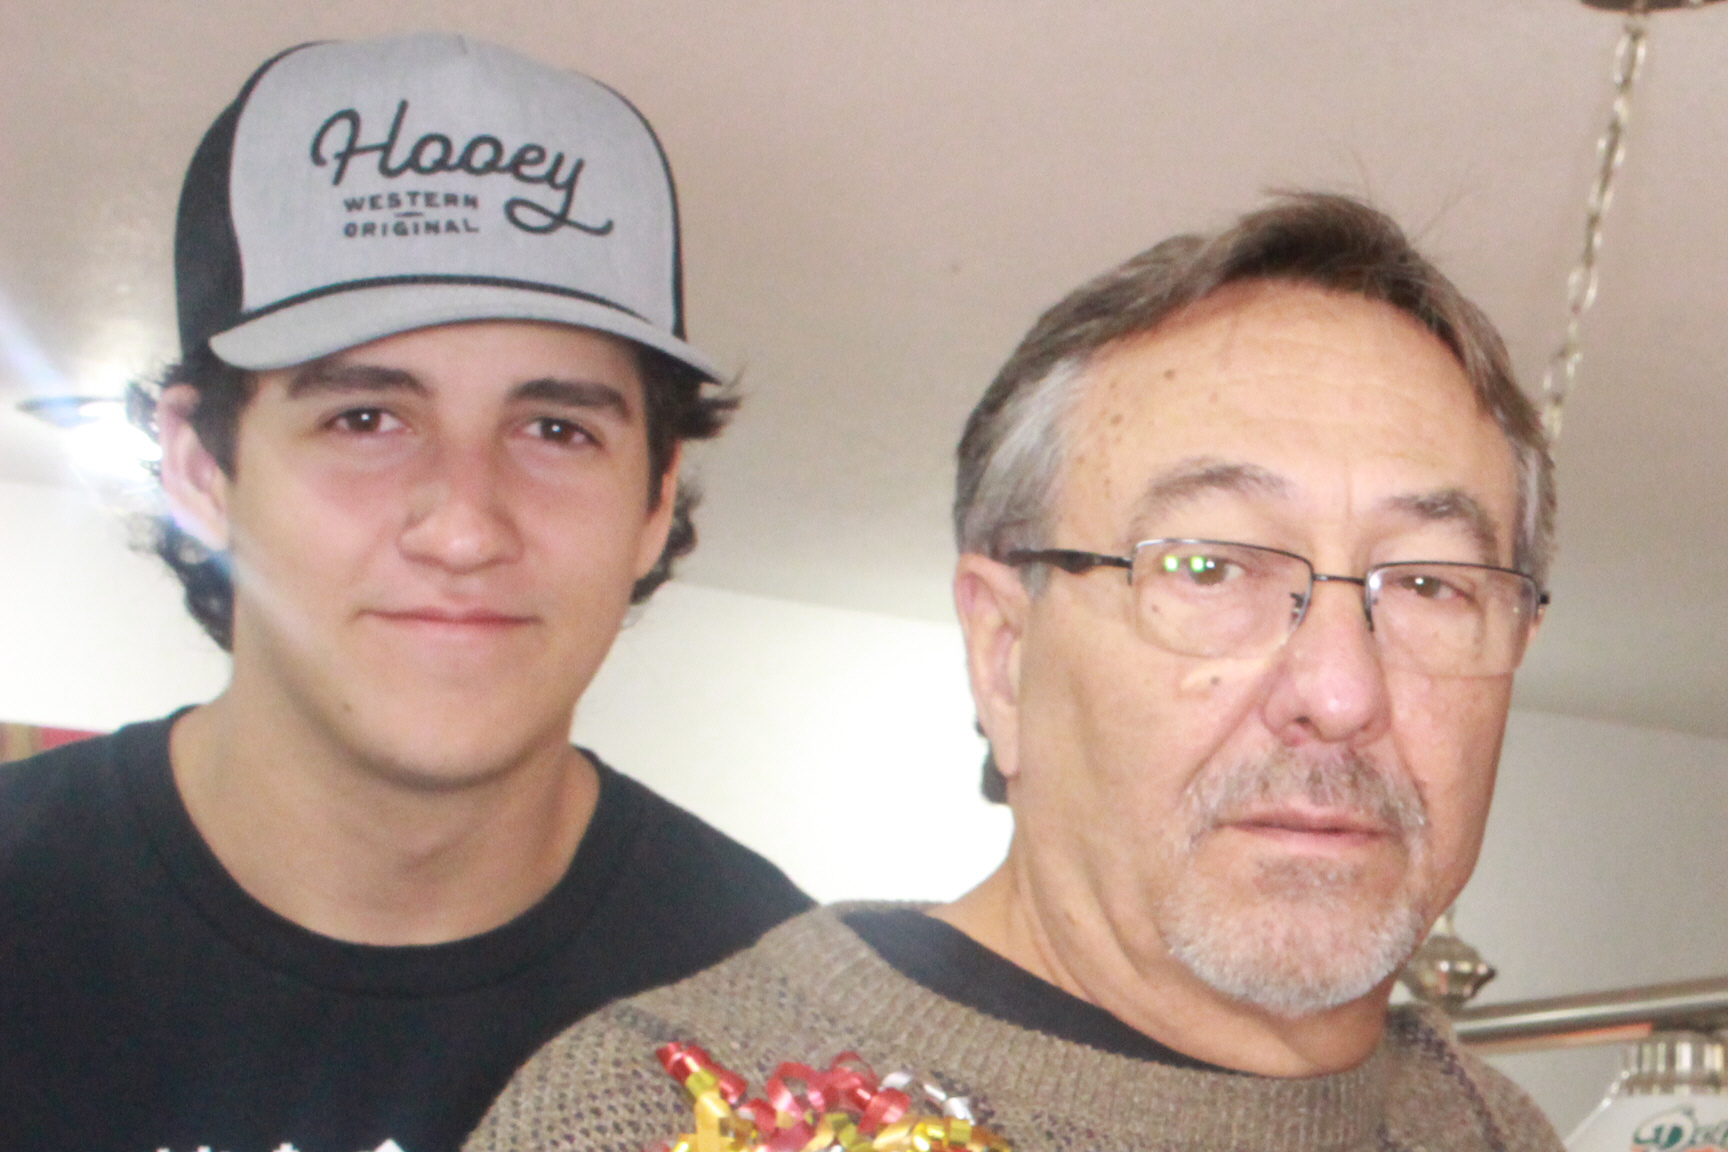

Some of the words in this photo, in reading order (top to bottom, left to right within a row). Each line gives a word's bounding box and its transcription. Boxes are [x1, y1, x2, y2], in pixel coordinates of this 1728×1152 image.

[310, 100, 614, 236] Hooey
[344, 191, 479, 212] WESTERN
[344, 218, 480, 237] ORIGINAL
